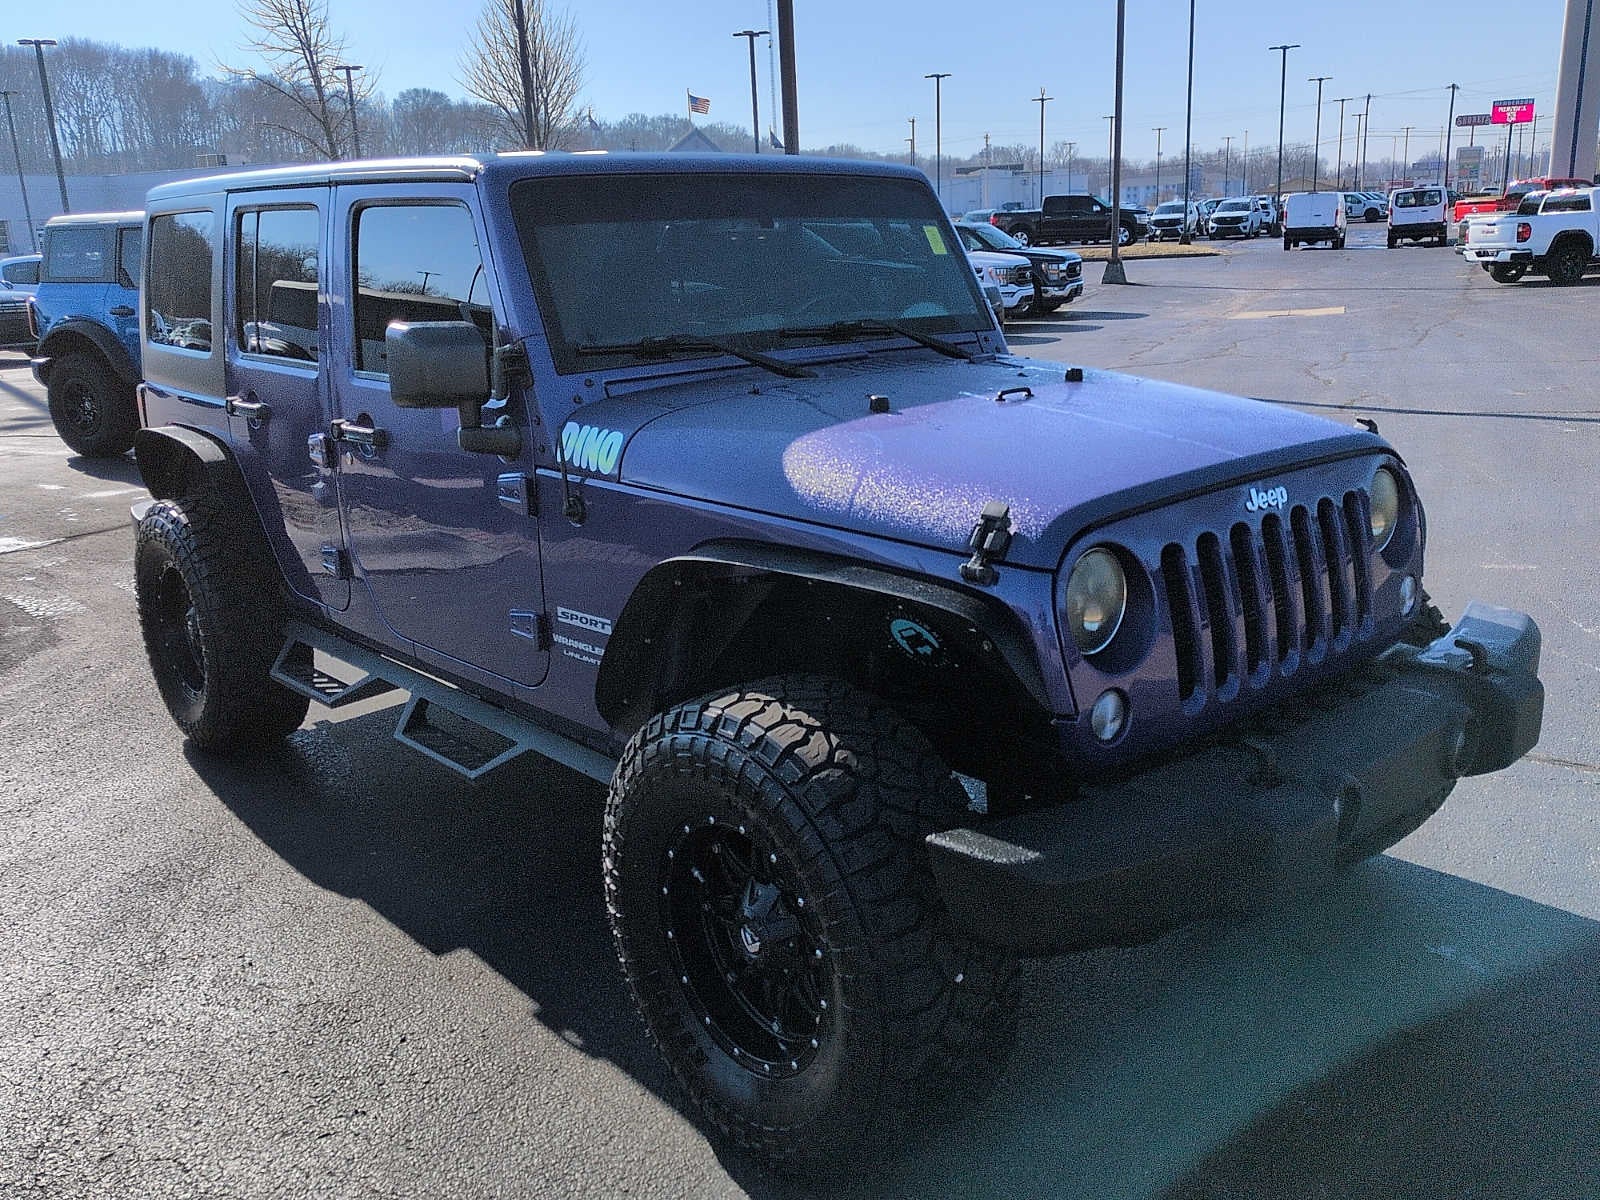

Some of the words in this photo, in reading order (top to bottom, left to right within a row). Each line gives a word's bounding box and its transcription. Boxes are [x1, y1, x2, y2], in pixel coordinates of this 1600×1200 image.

[557, 421, 624, 475] DINO
[1246, 486, 1288, 512] Jeep
[558, 611, 611, 631] SPORT
[563, 649, 601, 666] UNLIMIT
